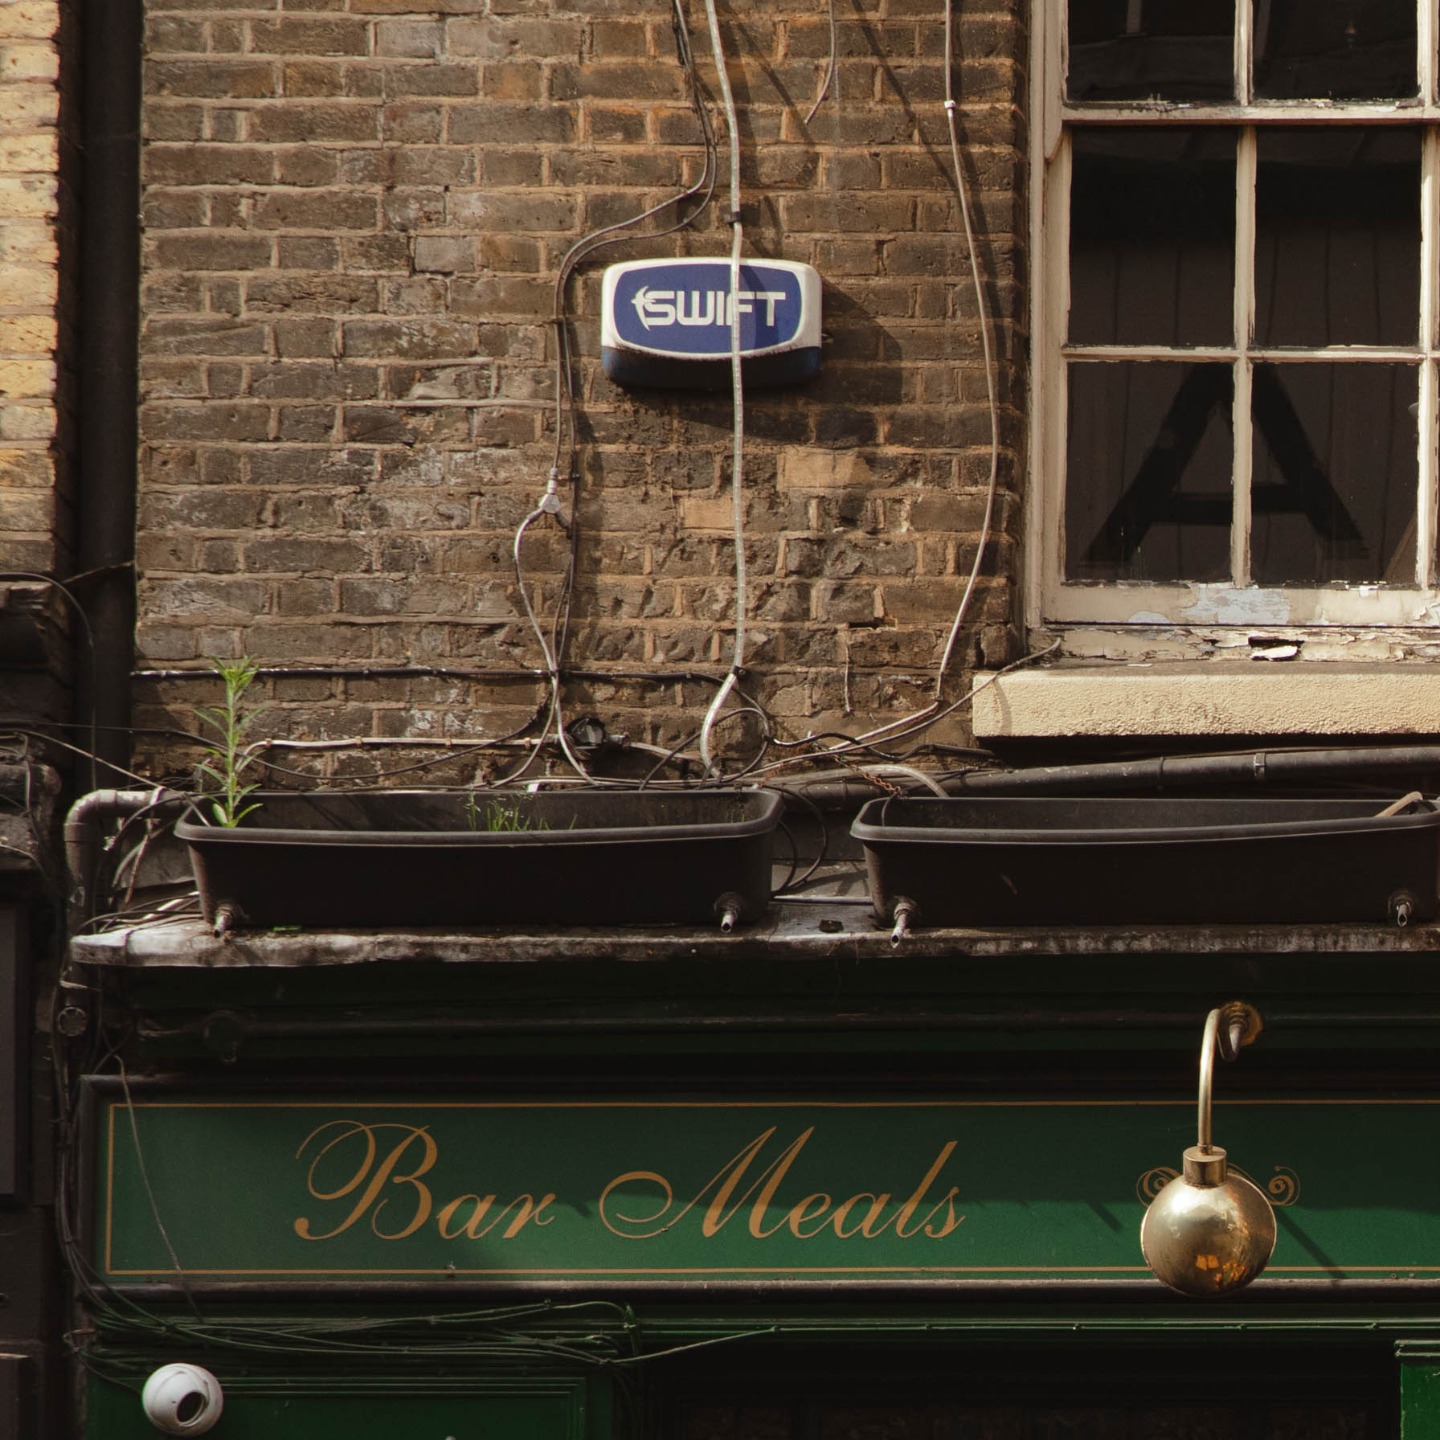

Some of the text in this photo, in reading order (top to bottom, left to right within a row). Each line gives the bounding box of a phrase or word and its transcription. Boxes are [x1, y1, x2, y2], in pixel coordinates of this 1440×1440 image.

[642, 290, 786, 327] SWIFT
[295, 1119, 967, 1241] Bar Meals
